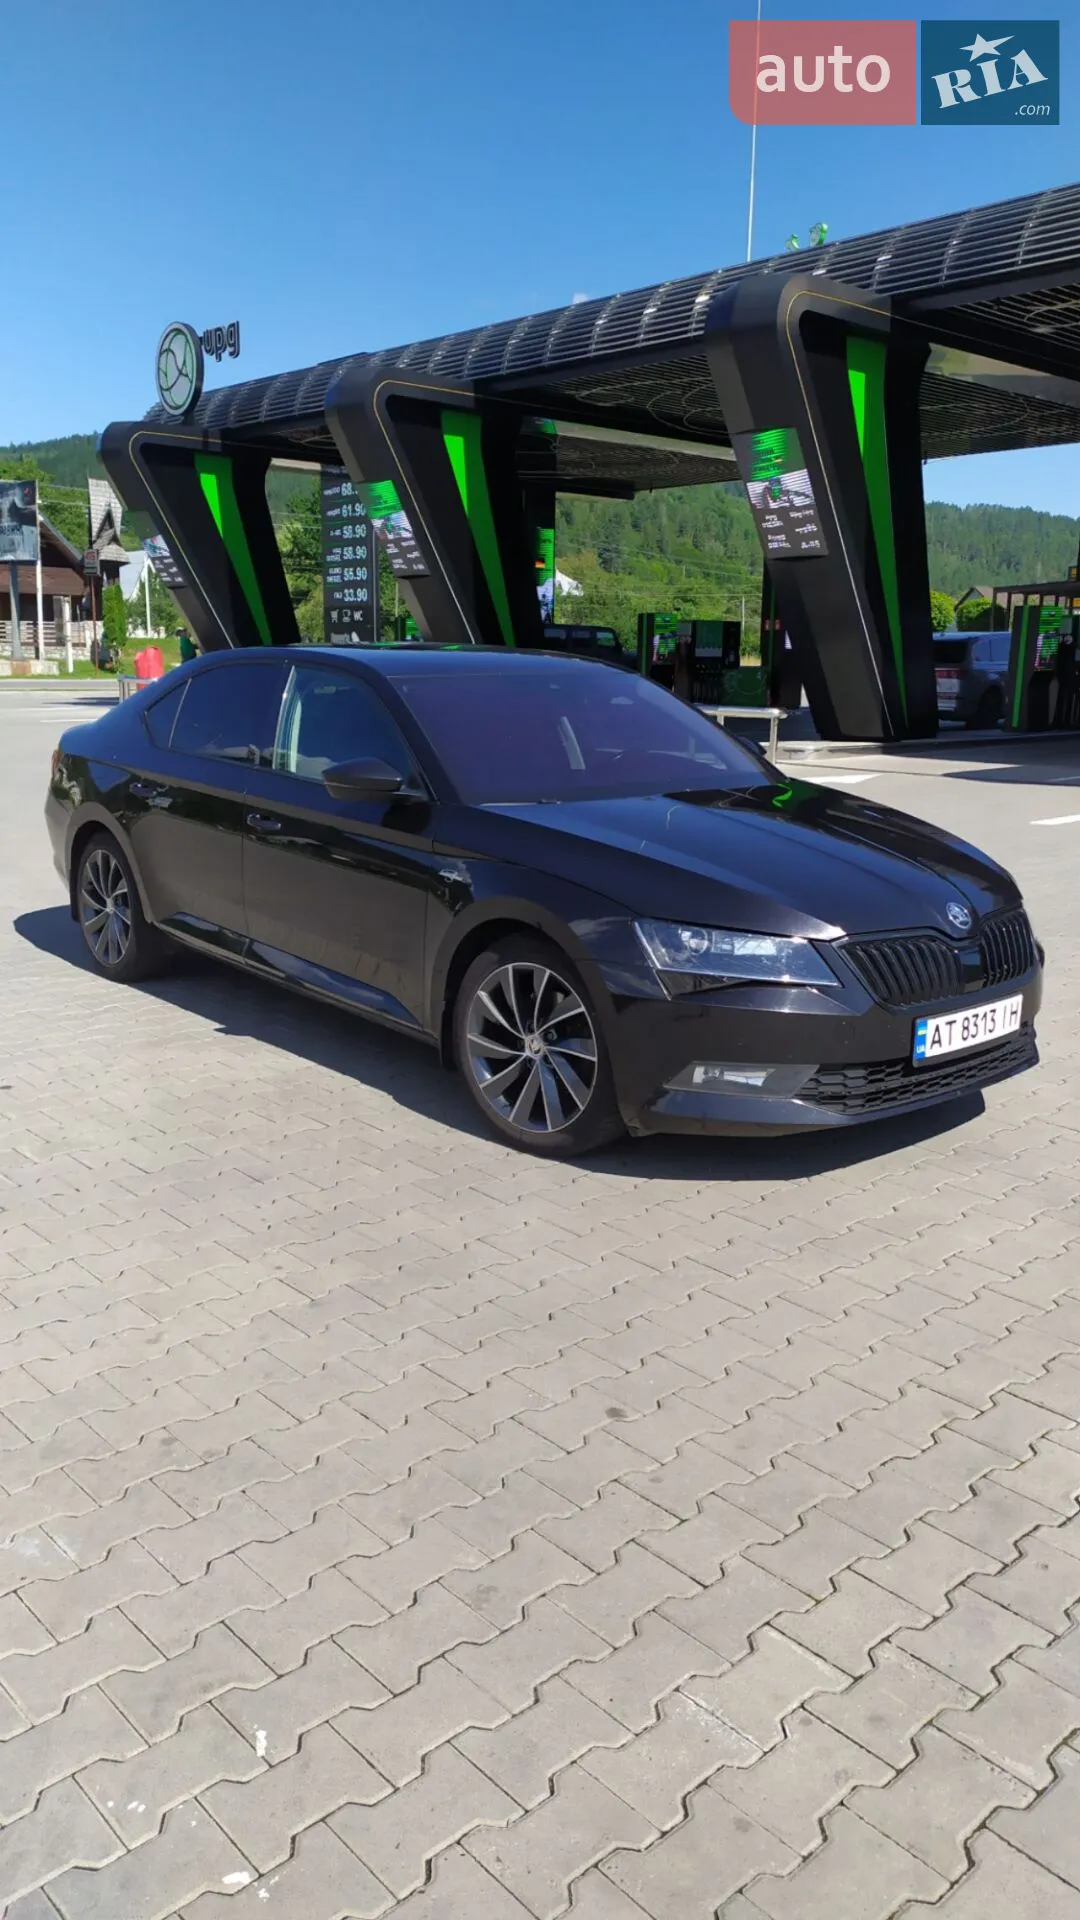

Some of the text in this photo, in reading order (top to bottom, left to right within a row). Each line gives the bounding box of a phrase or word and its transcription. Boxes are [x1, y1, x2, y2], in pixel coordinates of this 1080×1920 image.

[203, 320, 240, 362] upg
[342, 524, 367, 539] 58.90
[343, 545, 367, 560] 58.90
[343, 566, 367, 581] 55.90
[343, 588, 368, 602] 33.90
[353, 610, 363, 621] WC
[929, 1001, 1020, 1050] AT 8313 IH
